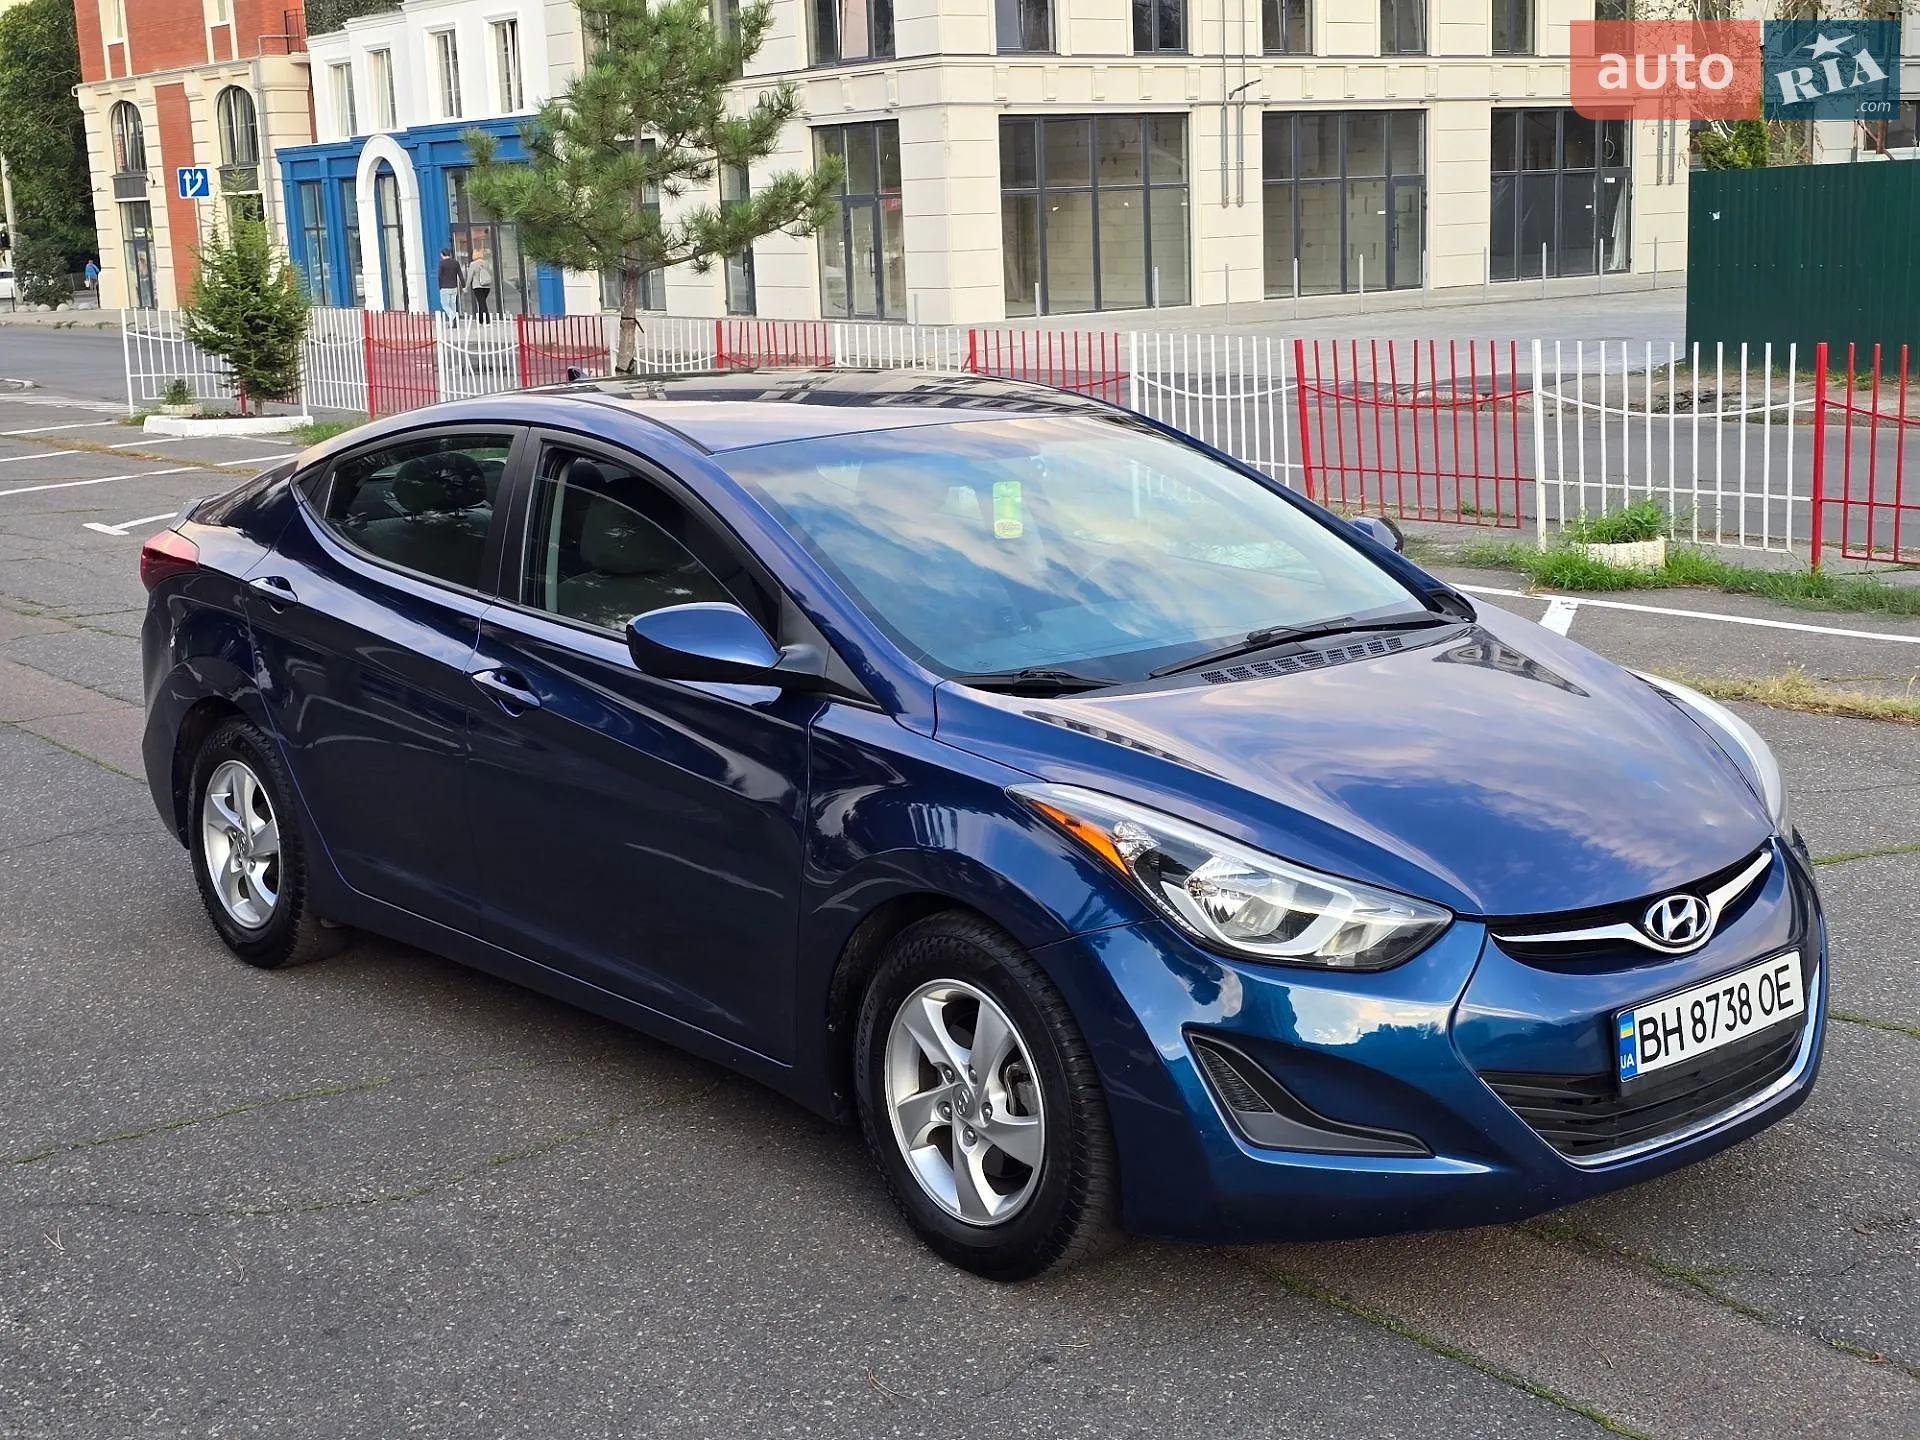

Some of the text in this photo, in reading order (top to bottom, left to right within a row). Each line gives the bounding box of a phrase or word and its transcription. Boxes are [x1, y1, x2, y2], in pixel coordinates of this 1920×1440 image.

[1638, 964, 1794, 1064] BH 8738 OE
[1620, 1053, 1635, 1070] UA
